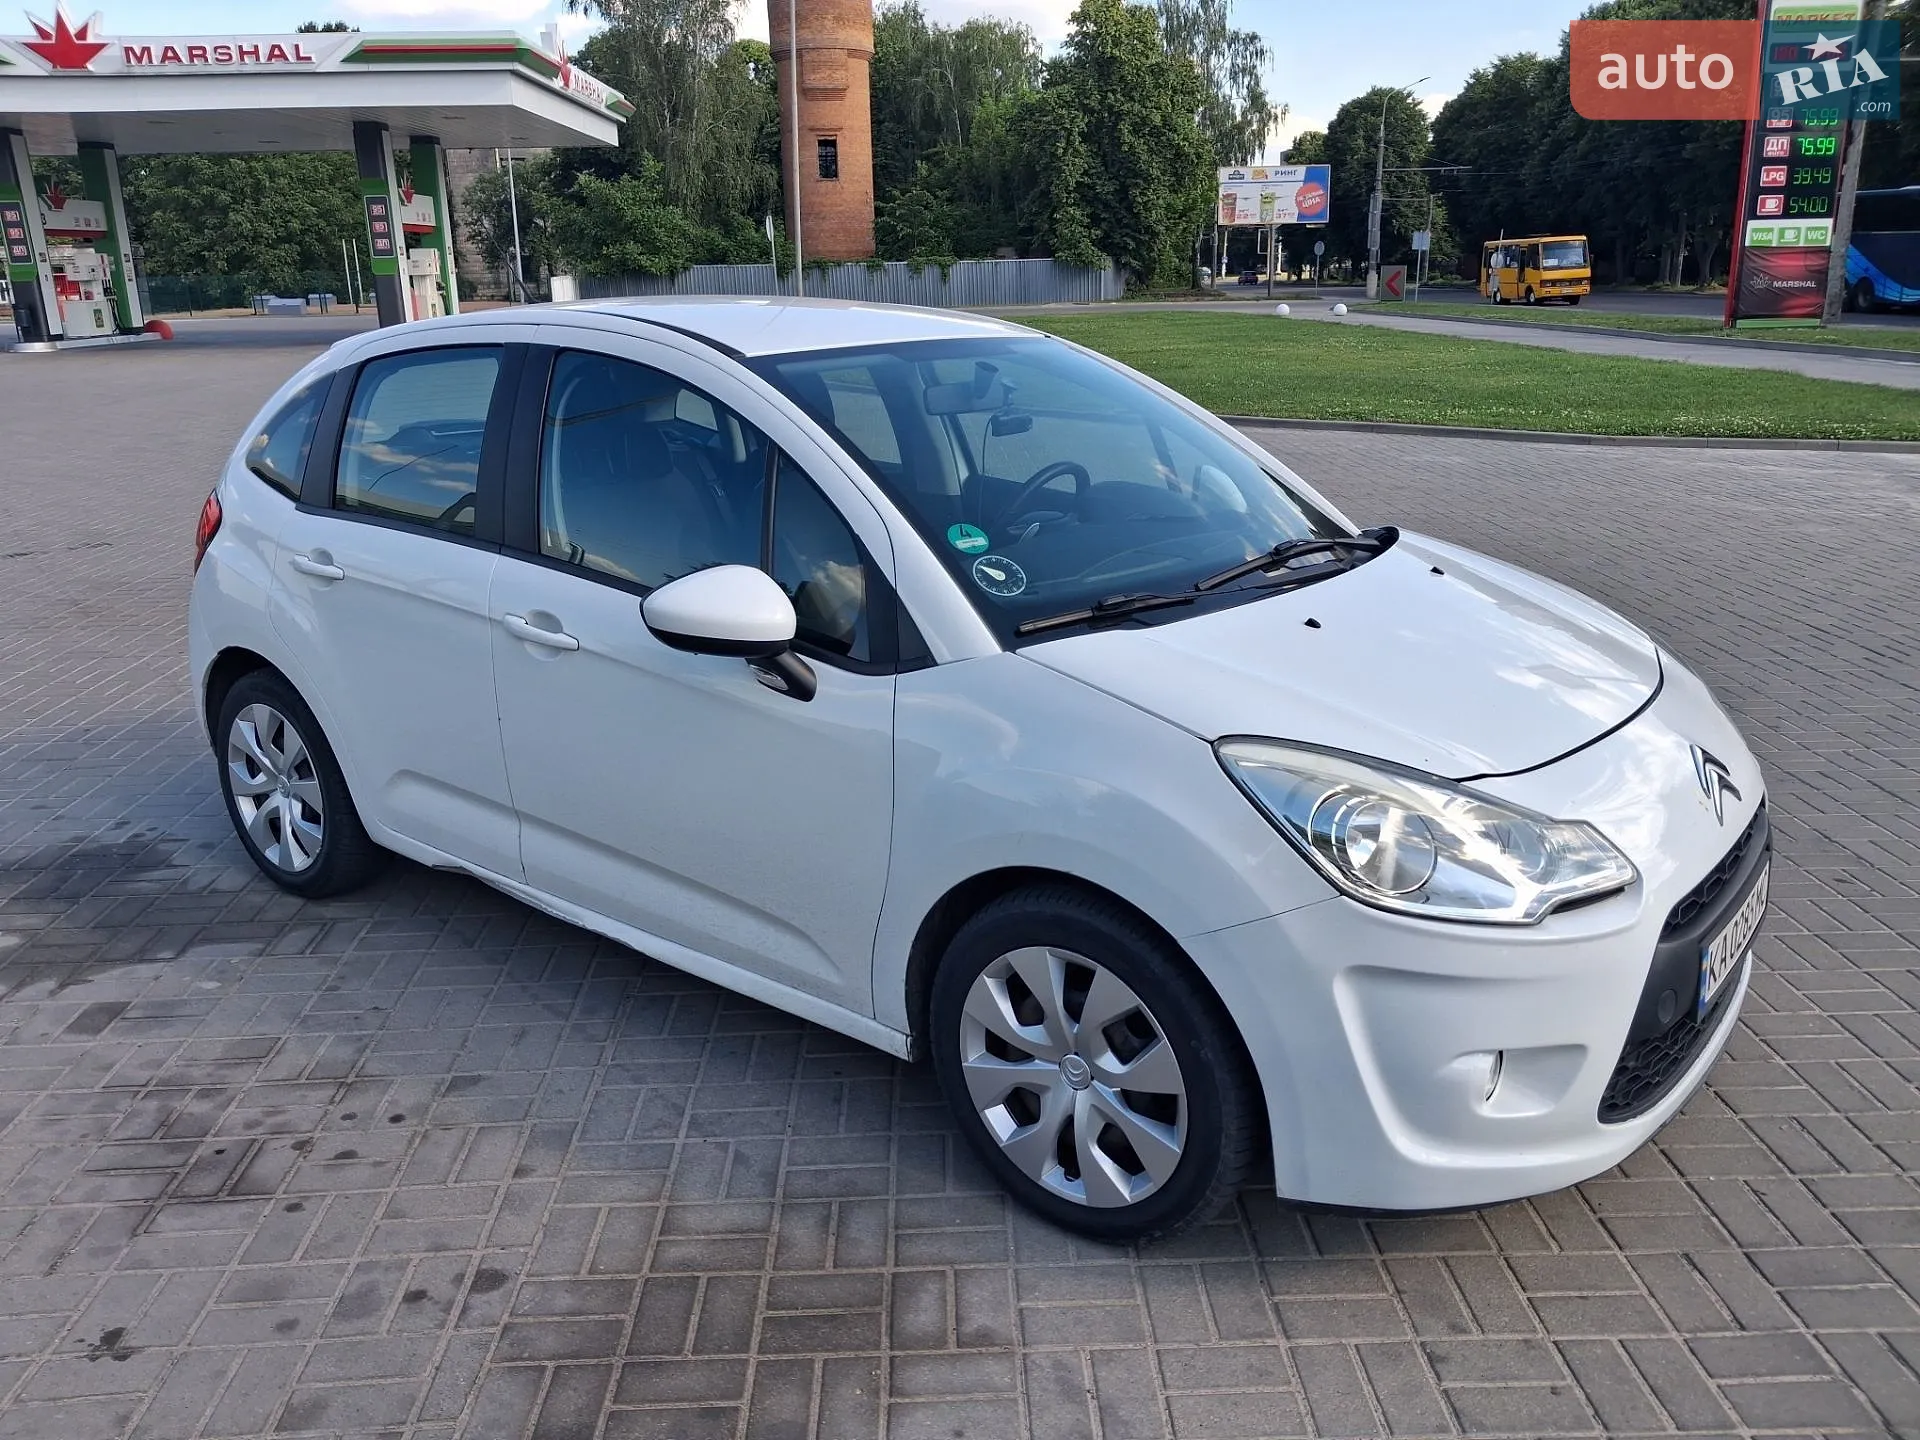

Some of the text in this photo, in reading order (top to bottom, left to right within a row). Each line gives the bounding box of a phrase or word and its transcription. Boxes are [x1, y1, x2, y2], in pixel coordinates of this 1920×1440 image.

[123, 42, 314, 66] MARSHAL
[1801, 108, 1839, 126] 75.99
[1767, 138, 1788, 151] ДП
[1797, 137, 1836, 155] 75.99
[1763, 171, 1784, 181] LPG
[1793, 167, 1832, 184] 39.49
[1789, 196, 1828, 213] 54.00
[1752, 231, 1773, 241] VISA
[1807, 230, 1826, 240] WC
[1772, 280, 1817, 288] MARSHAL
